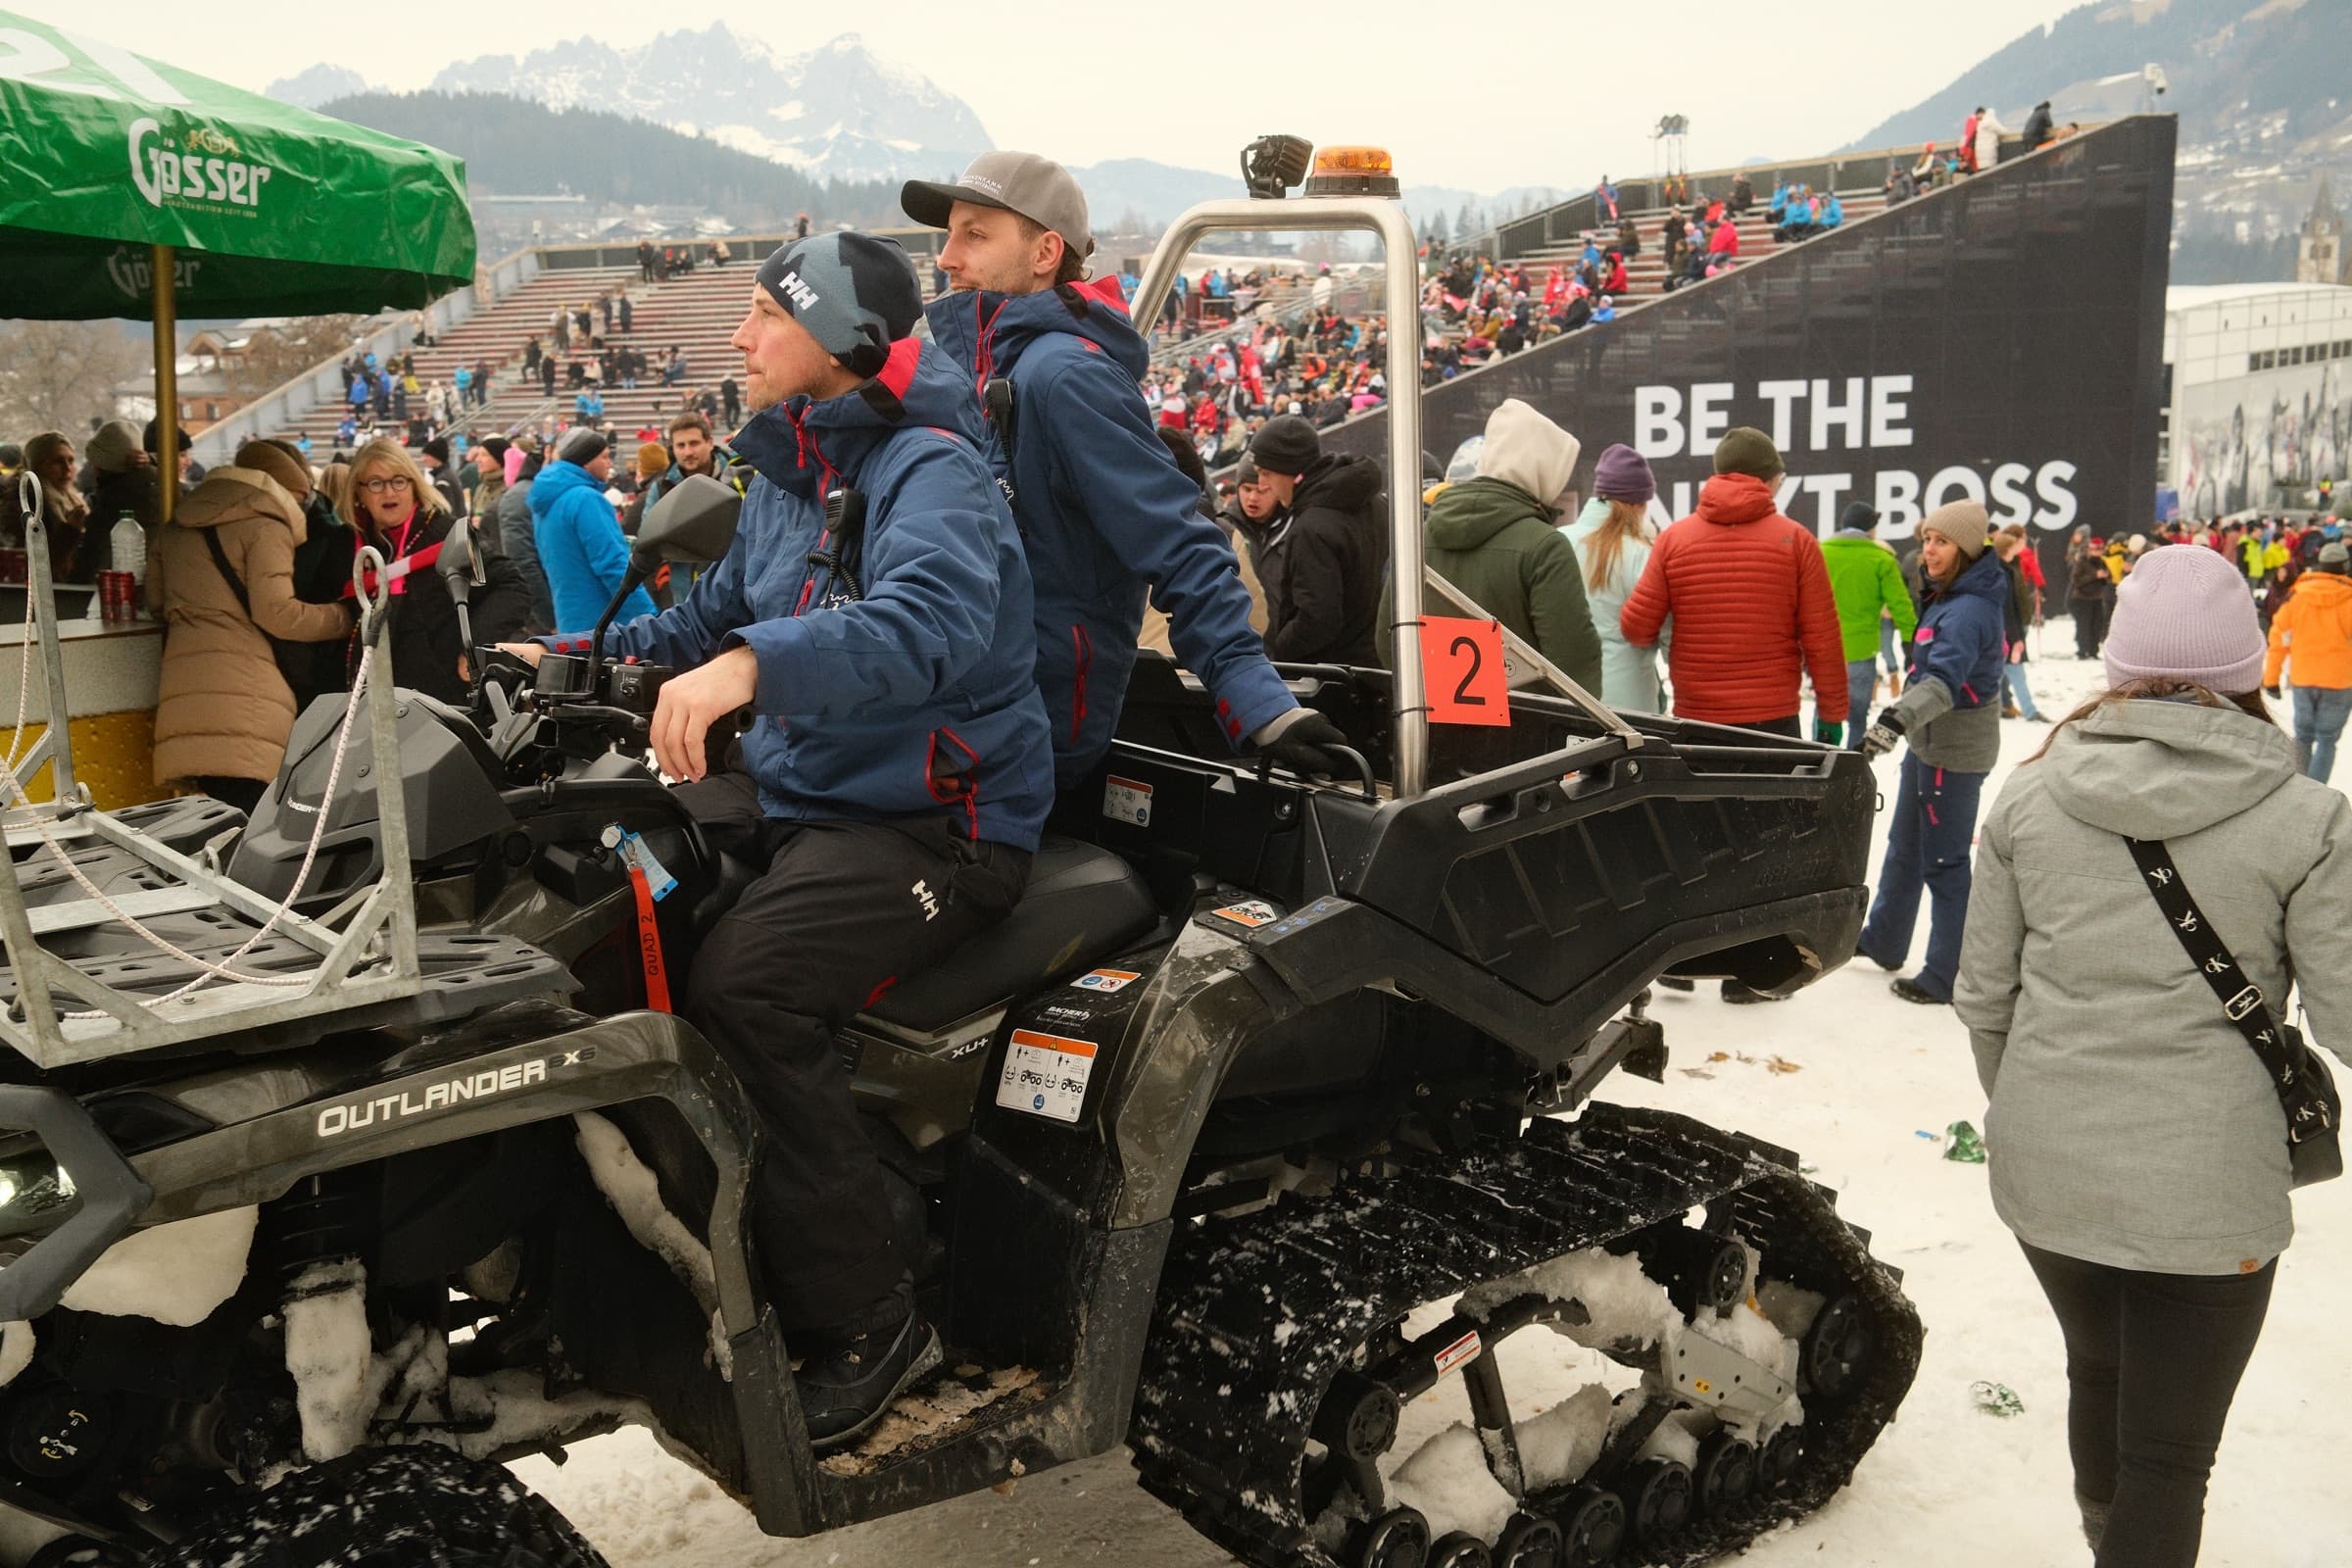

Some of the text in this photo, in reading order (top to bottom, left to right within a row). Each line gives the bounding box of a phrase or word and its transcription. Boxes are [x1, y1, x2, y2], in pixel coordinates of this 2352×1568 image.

[128, 118, 271, 208] Gösser
[778, 270, 820, 311] HH
[1634, 375, 1913, 458] BE THE
[1875, 461, 2078, 540] BOSS
[1449, 636, 1486, 706] 2
[641, 911, 660, 976] QUAD 2
[951, 1037, 989, 1059] XU+
[318, 1058, 546, 1138] OUTLANDER
